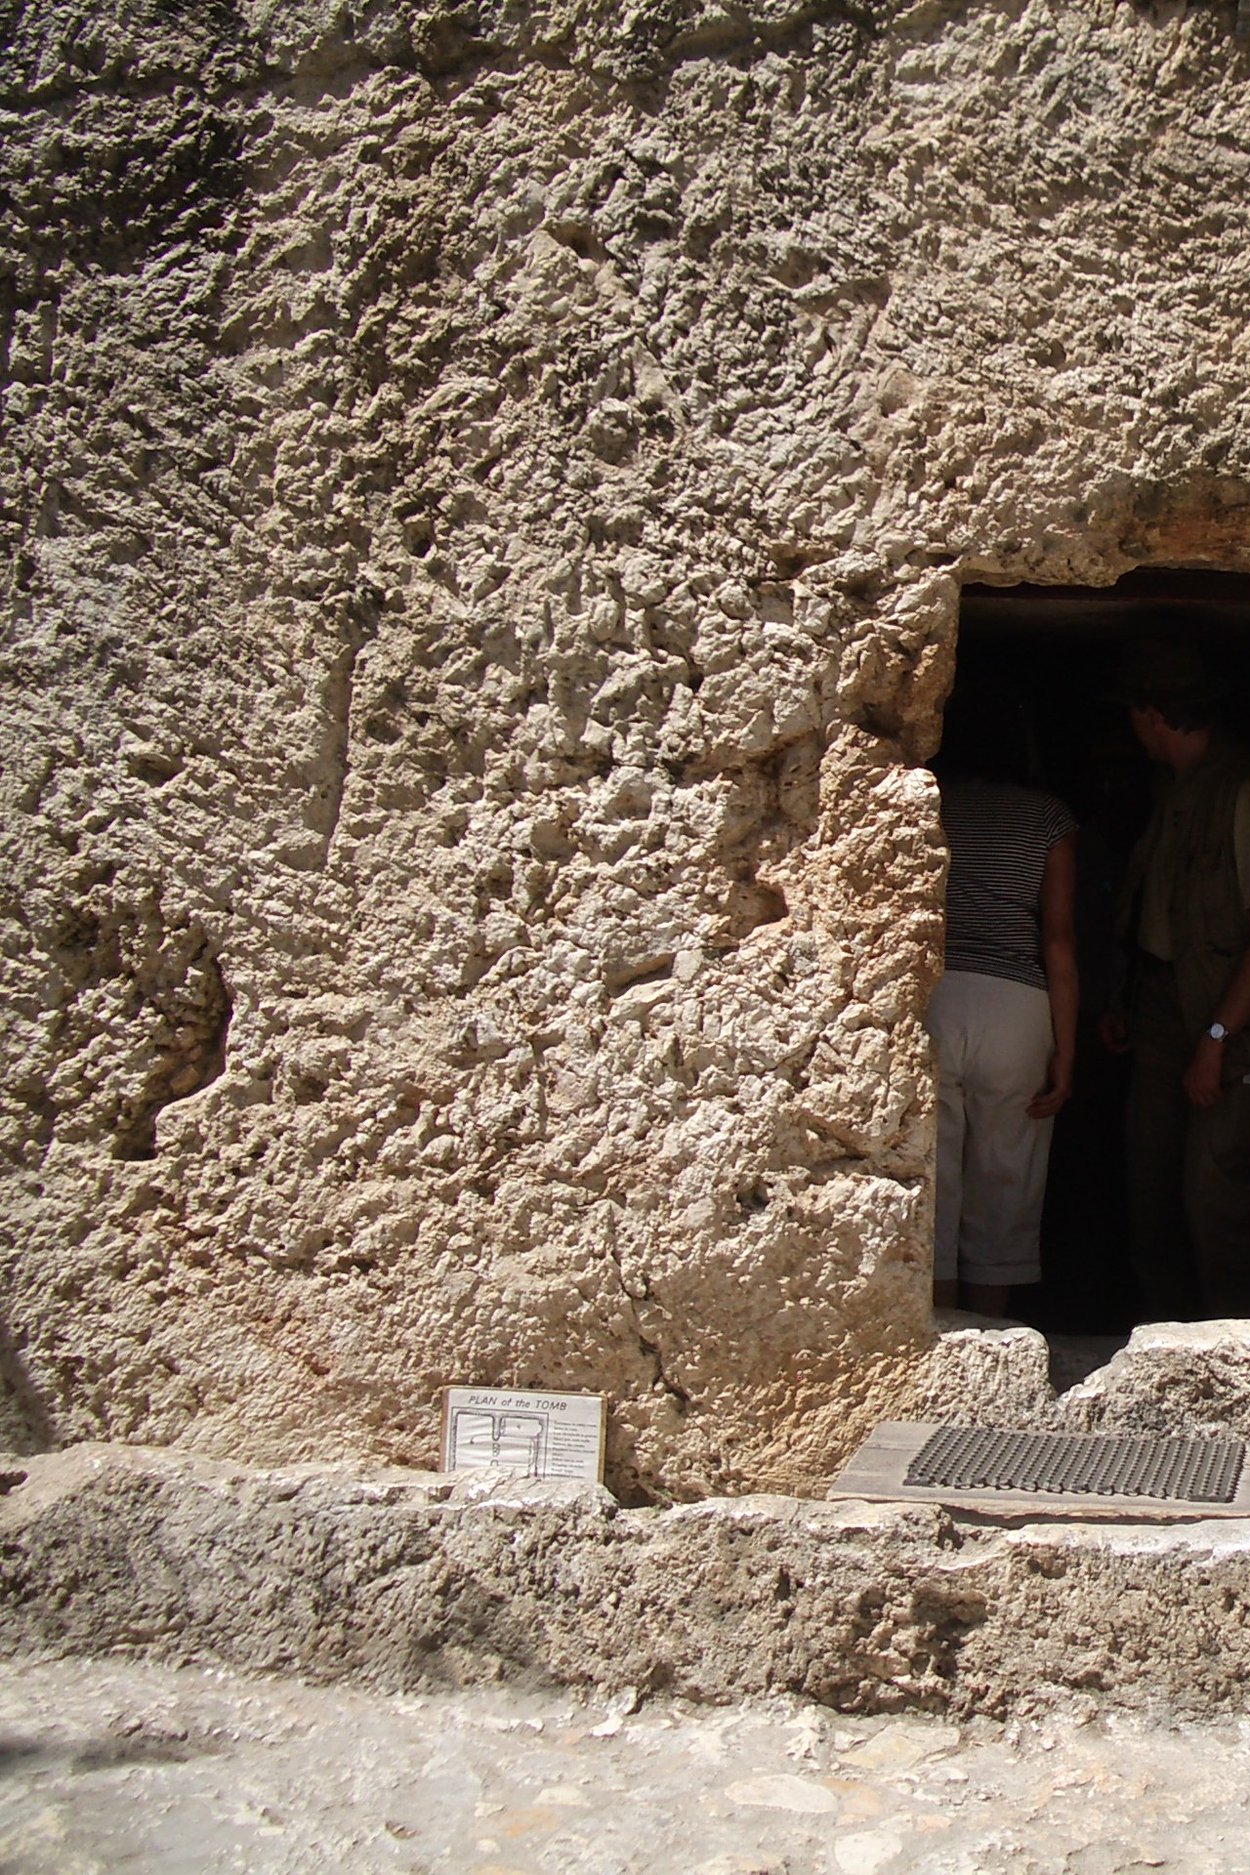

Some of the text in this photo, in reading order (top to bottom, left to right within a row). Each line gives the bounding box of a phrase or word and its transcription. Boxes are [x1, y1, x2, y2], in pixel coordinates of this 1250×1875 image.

[468, 1395, 567, 1411] PLAN of the TOMB
